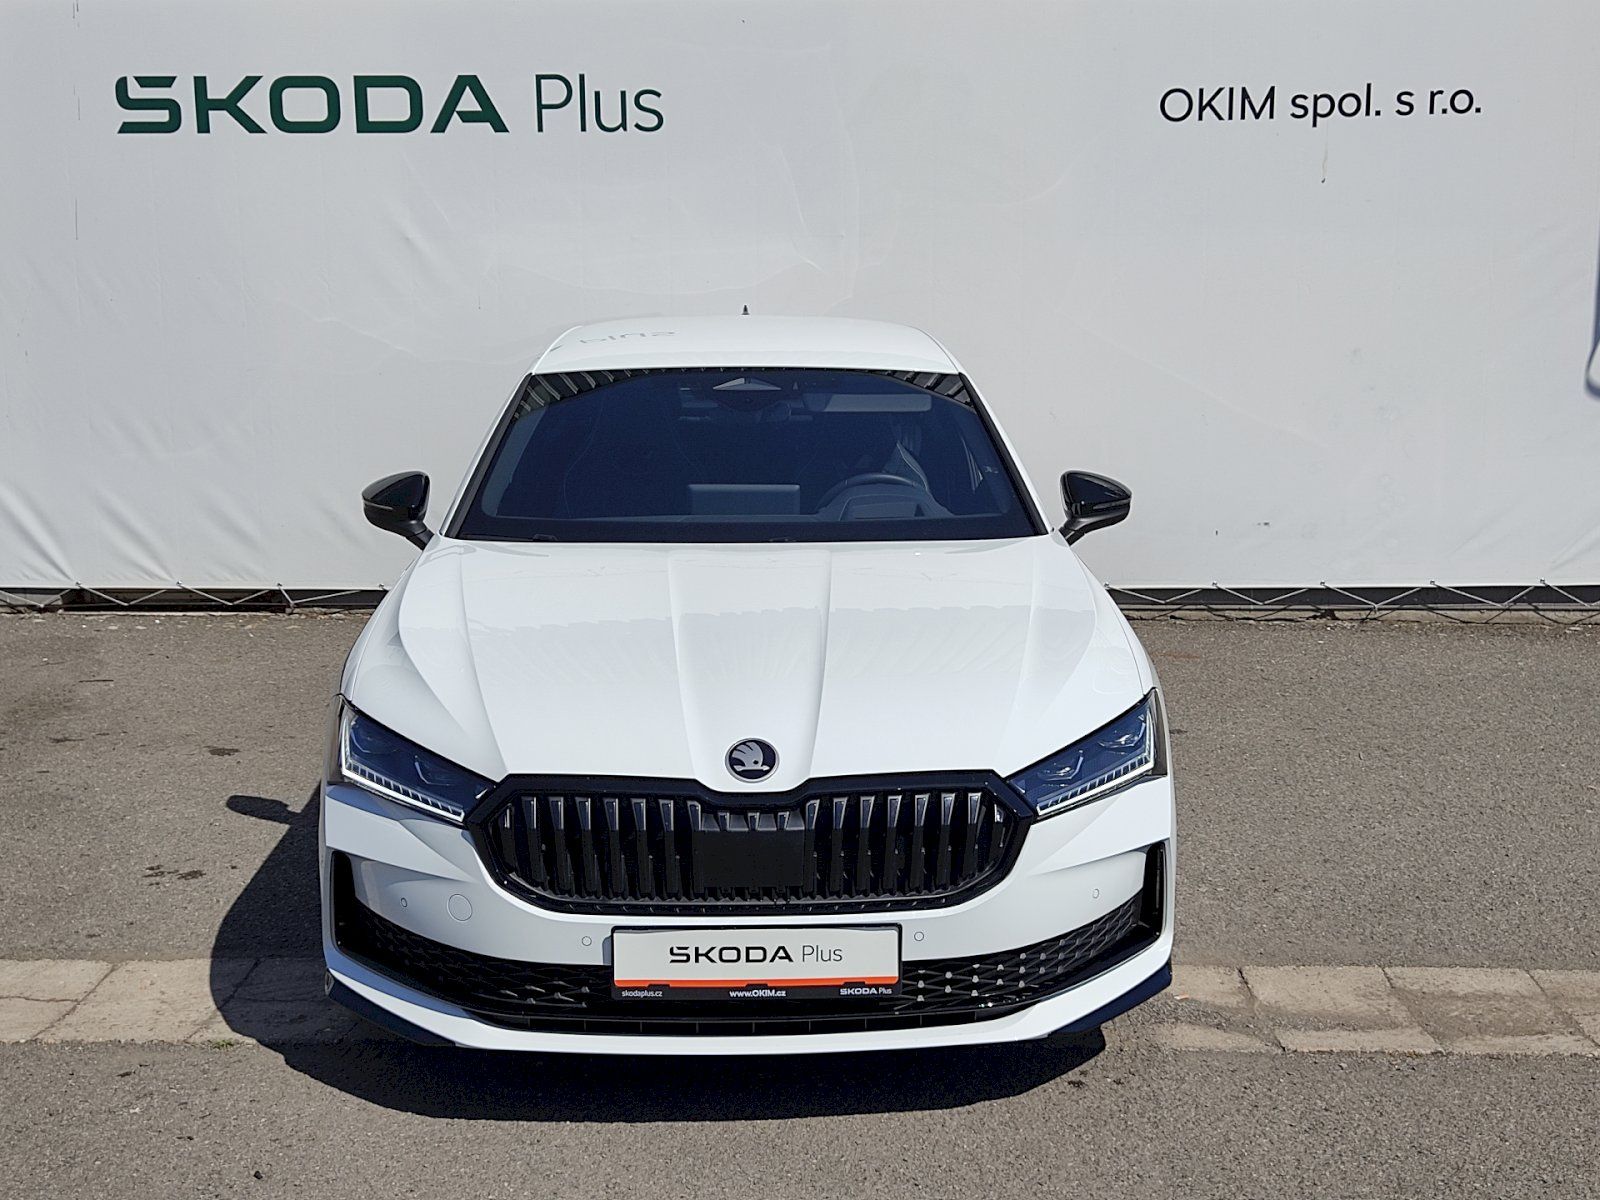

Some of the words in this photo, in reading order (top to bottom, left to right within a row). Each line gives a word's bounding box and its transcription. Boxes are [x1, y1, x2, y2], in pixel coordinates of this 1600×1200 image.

[535, 74, 664, 134] Plus
[1159, 85, 1276, 123] OKIM
[1289, 83, 1382, 129] spol.
[1394, 89, 1415, 117] s
[1427, 84, 1482, 117] r.o.
[801, 944, 843, 963] Plus
[621, 989, 663, 998] skodaplus.cz
[729, 989, 787, 998] www.OKIM.cz
[878, 986, 892, 995] Plus
